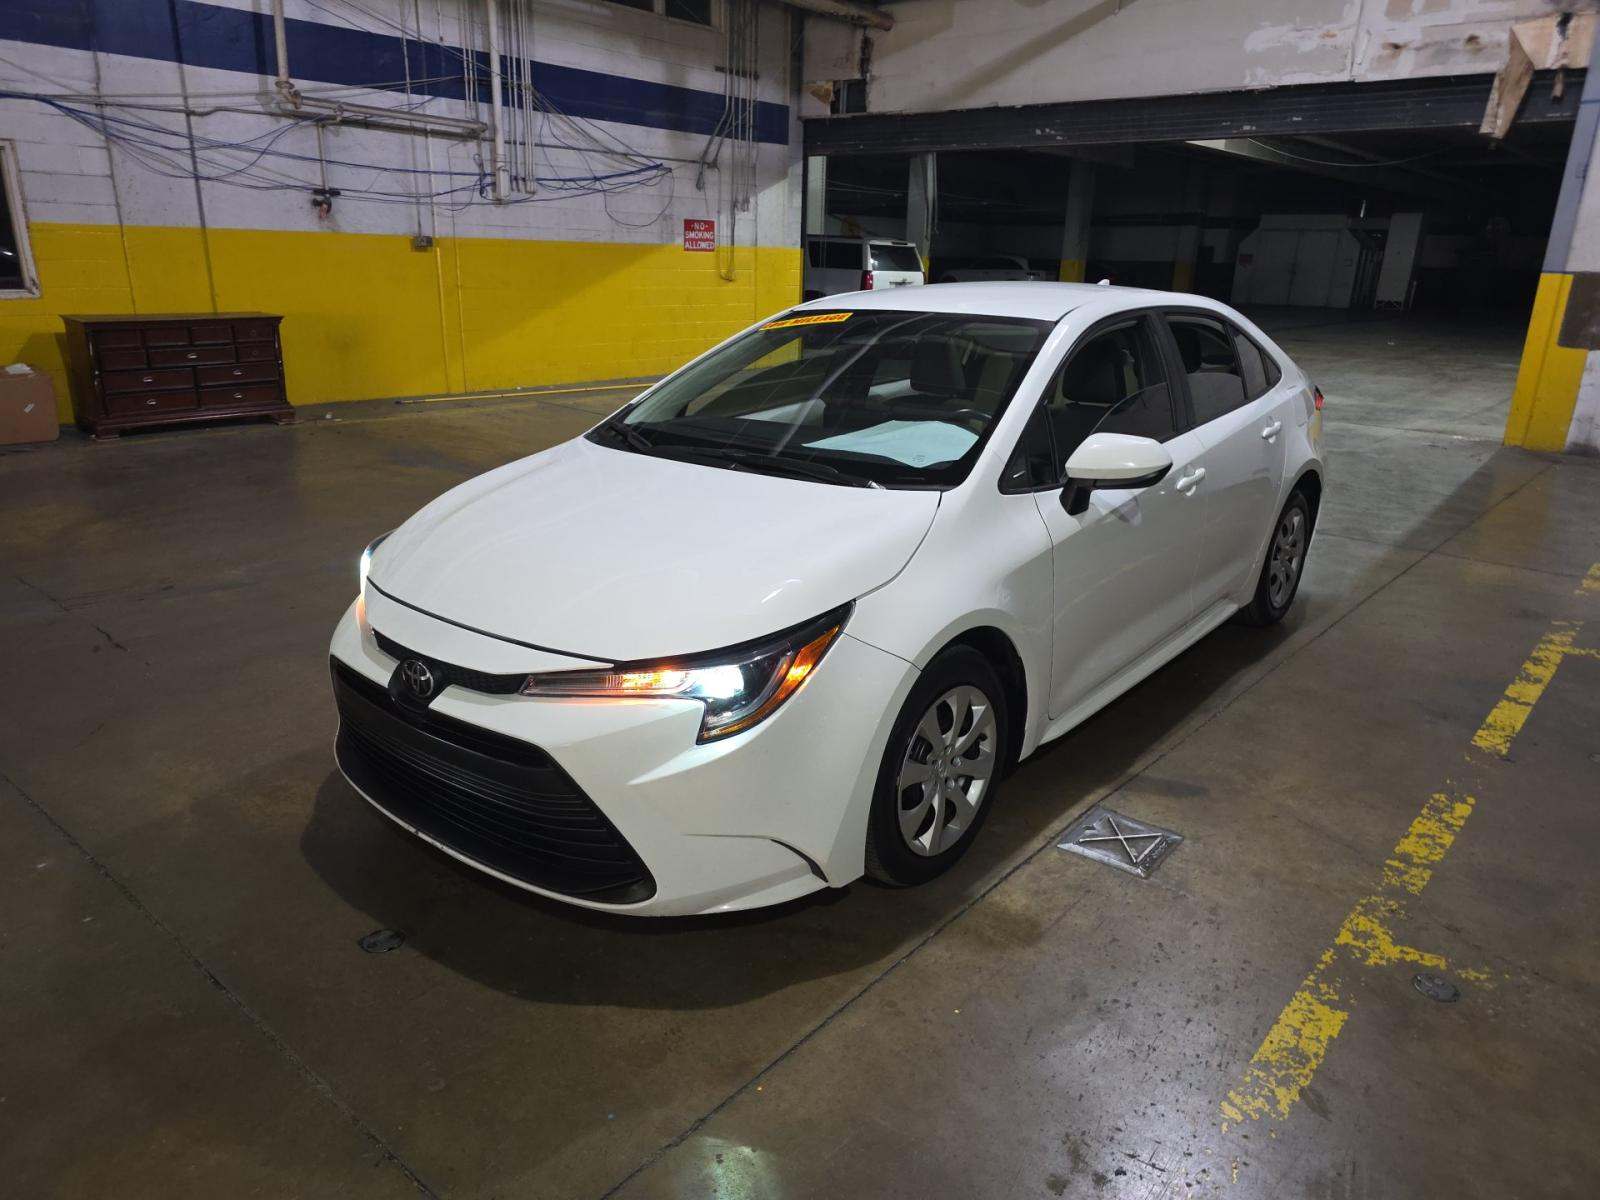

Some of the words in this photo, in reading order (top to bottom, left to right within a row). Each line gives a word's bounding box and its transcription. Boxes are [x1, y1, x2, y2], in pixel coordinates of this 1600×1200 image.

[685, 231, 714, 239] SMOKING
[685, 241, 715, 249] ALLOWED
[792, 313, 849, 324] MILEAGE
